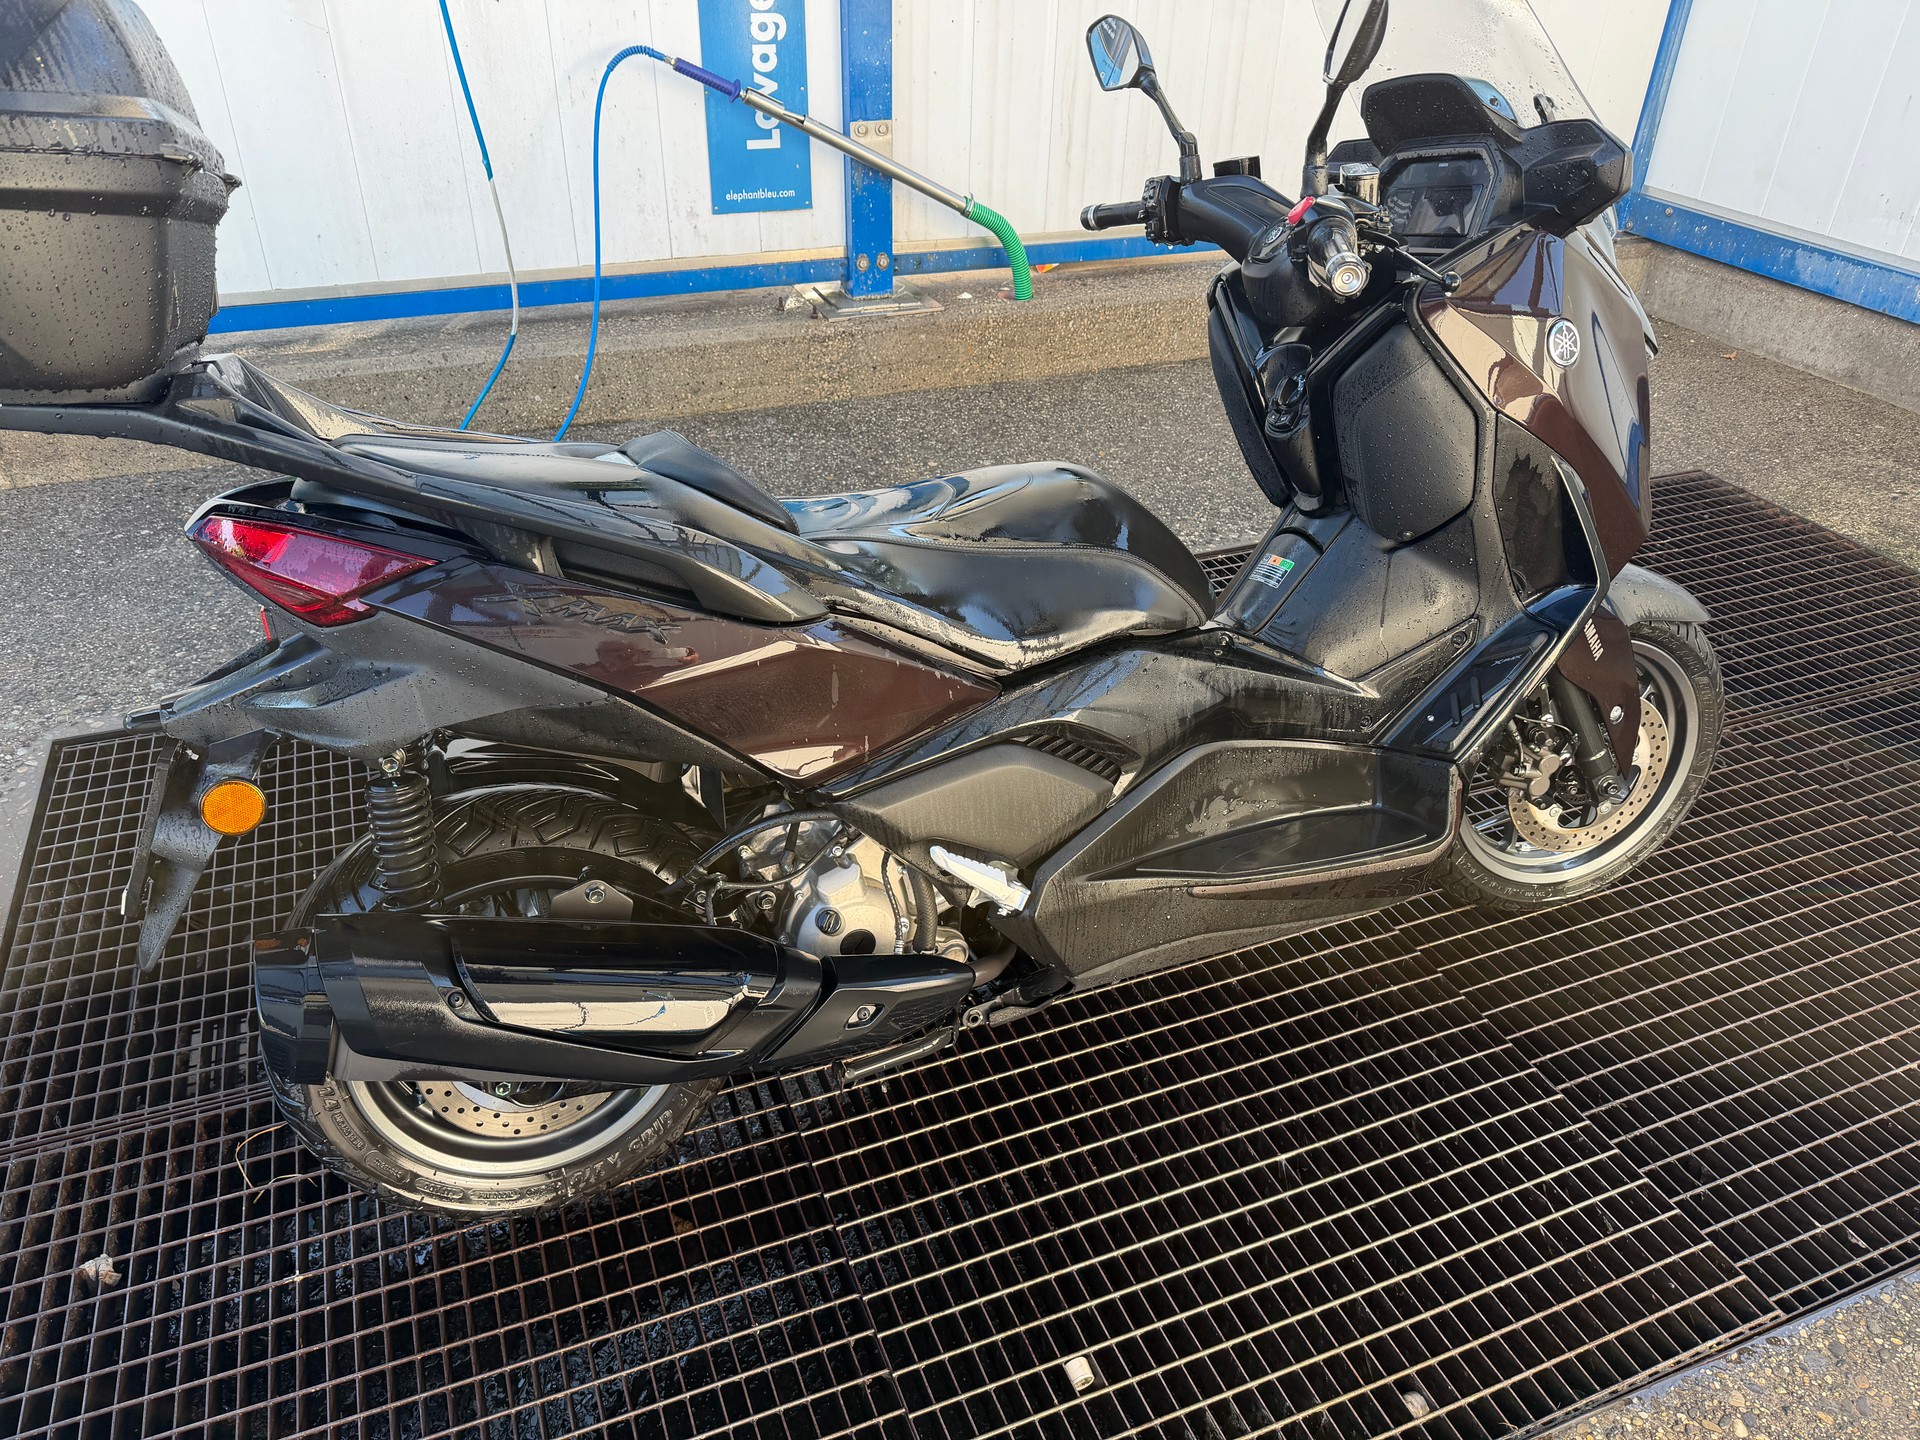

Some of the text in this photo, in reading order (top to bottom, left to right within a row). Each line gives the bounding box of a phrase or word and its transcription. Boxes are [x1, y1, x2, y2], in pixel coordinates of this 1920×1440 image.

[725, 188, 796, 203] elephantbleu.com
[1583, 618, 1604, 662] AMAHA
[628, 1110, 674, 1154] GRIP
